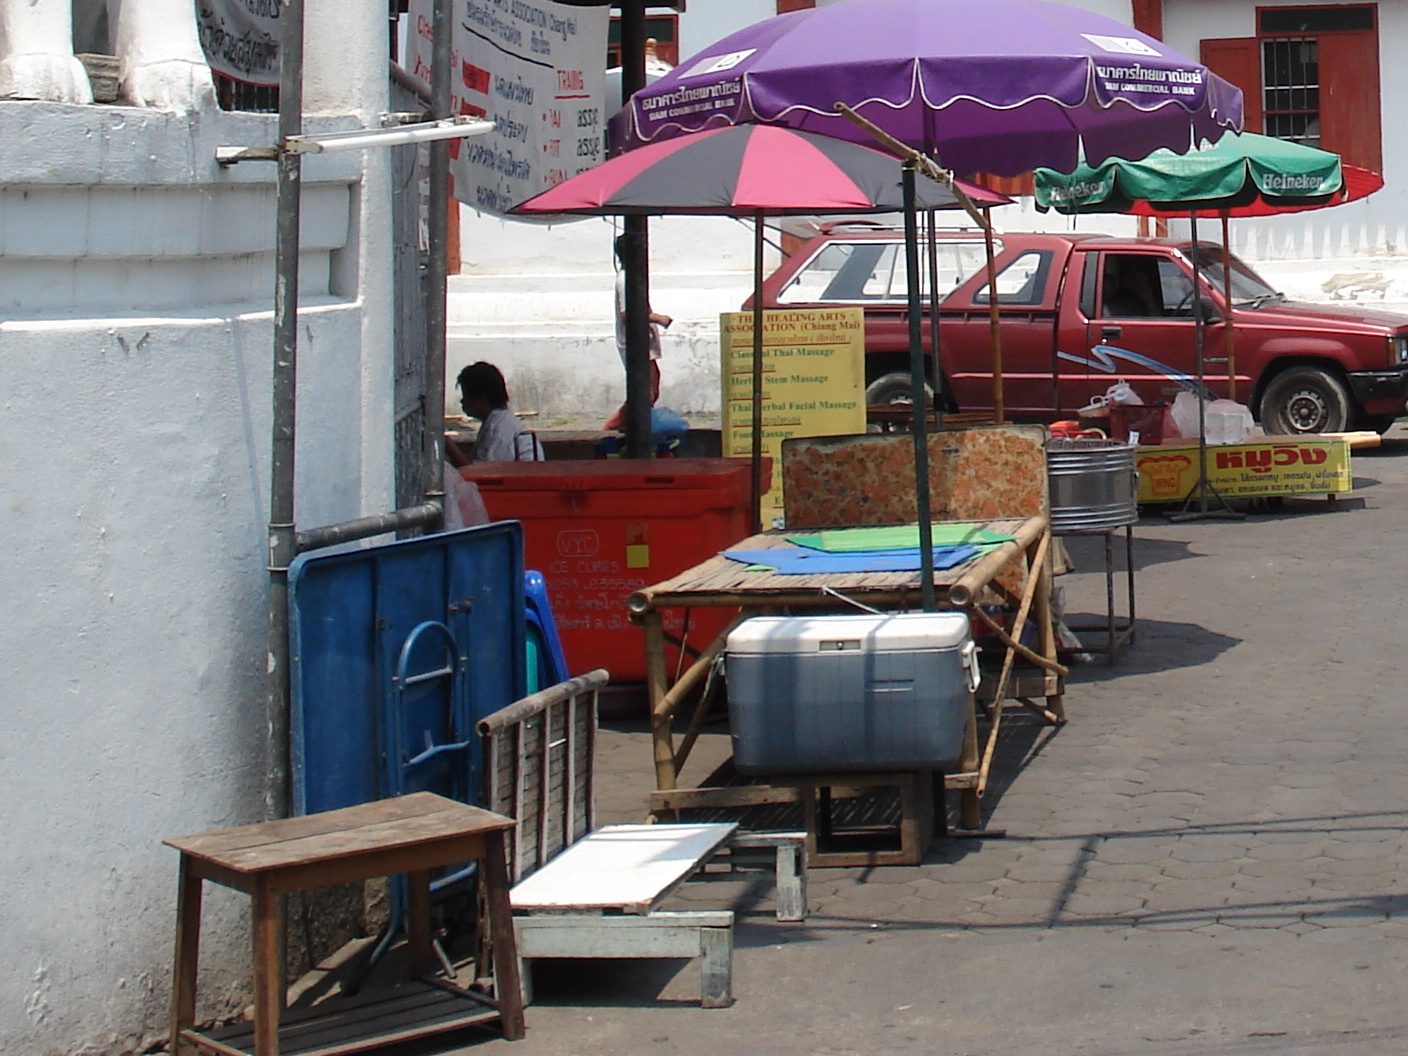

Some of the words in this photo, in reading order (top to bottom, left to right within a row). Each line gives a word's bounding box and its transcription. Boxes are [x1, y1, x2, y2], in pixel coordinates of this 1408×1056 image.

[642, 77, 741, 110] ธนาคารไทยพาณิชย์
[766, 313, 815, 323] HEALING
[818, 312, 846, 321] ARTS
[774, 348, 793, 357] Thai
[797, 347, 834, 358] Massage
[790, 375, 828, 384] Massage
[761, 402, 786, 411] erbal
[789, 401, 816, 410] Facial
[819, 400, 857, 410] Massage
